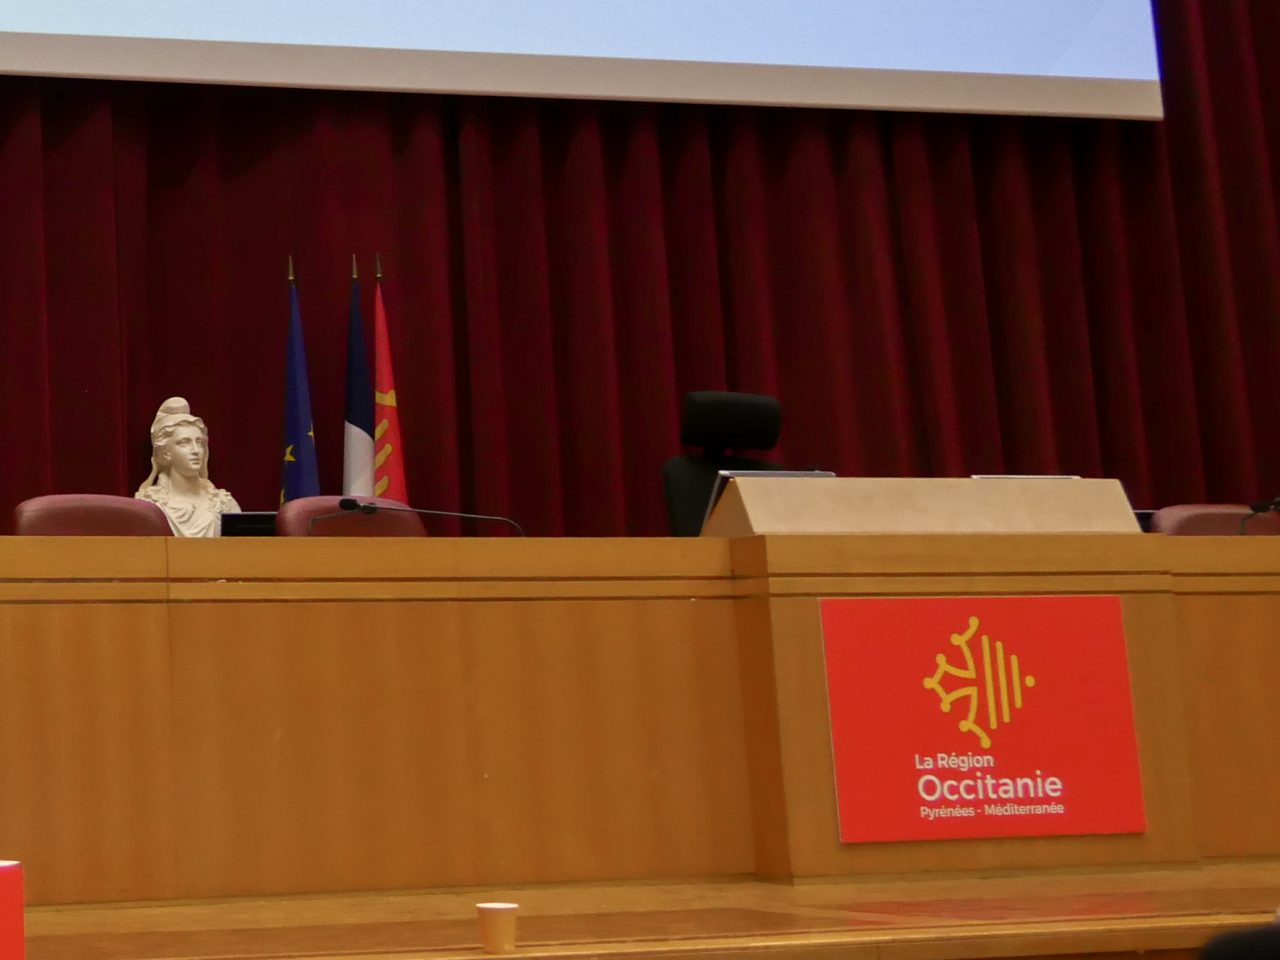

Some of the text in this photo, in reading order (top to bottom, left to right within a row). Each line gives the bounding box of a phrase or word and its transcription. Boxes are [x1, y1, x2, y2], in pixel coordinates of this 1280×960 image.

[915, 752, 994, 772] La Région
[918, 770, 1063, 801] Occitanie
[920, 804, 975, 820] Pyrénées
[984, 802, 1064, 816] Méditerranée
